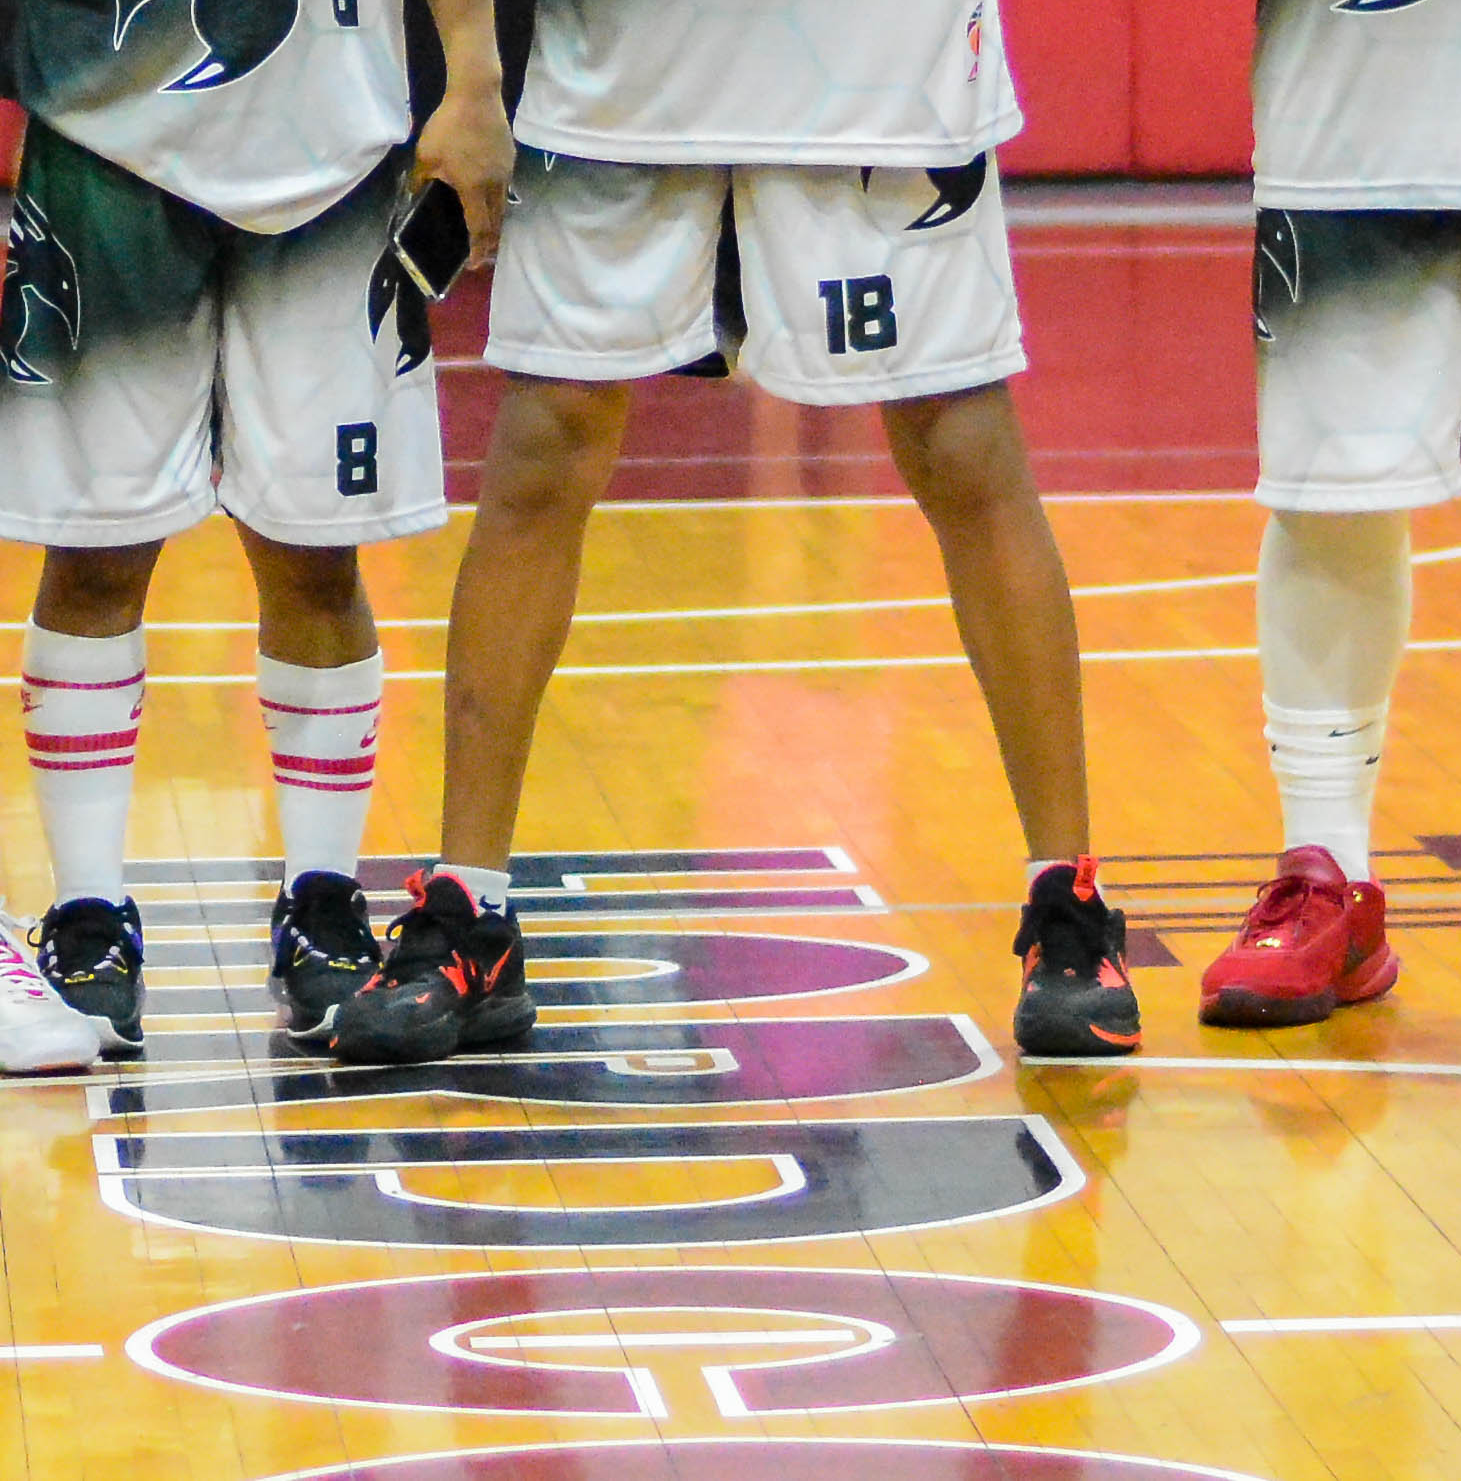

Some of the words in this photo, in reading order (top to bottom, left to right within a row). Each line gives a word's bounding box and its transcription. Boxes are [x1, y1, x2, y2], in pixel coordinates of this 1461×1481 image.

[818, 274, 898, 355] 18
[336, 422, 379, 497] 8
[84, 847, 1275, 1481] HARDC
